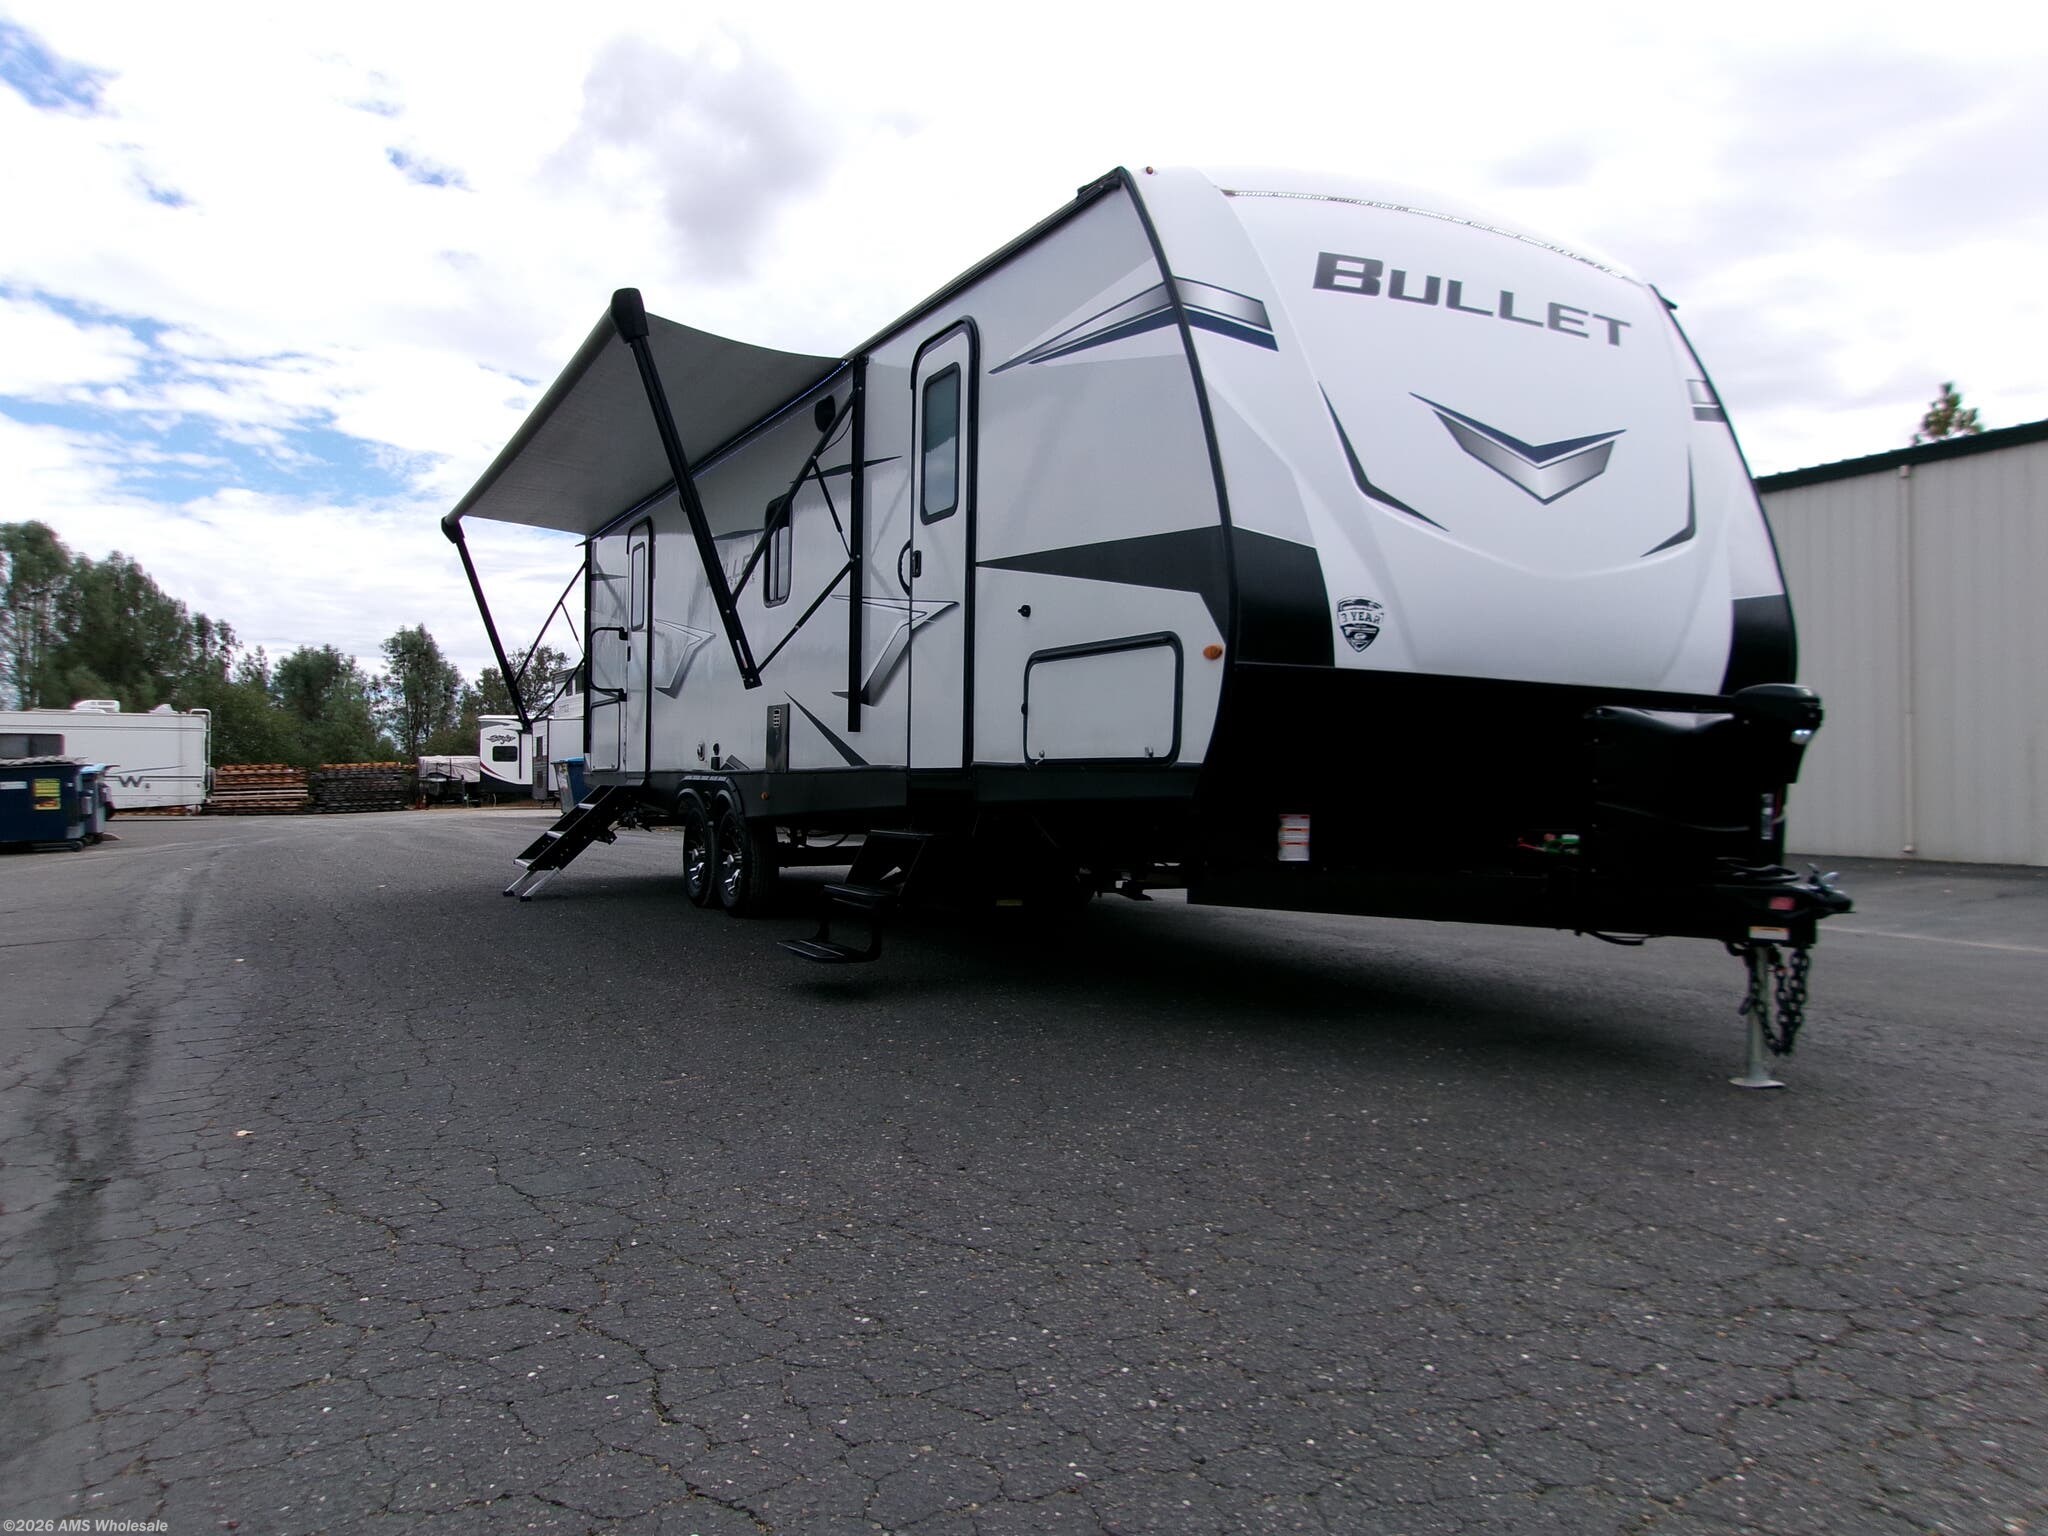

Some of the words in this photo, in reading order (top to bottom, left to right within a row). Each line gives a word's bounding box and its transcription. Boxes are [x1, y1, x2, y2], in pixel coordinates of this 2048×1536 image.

[1312, 251, 1632, 347] BULLET
[1340, 612, 1348, 623] 3
[1350, 611, 1381, 625] YEAR
